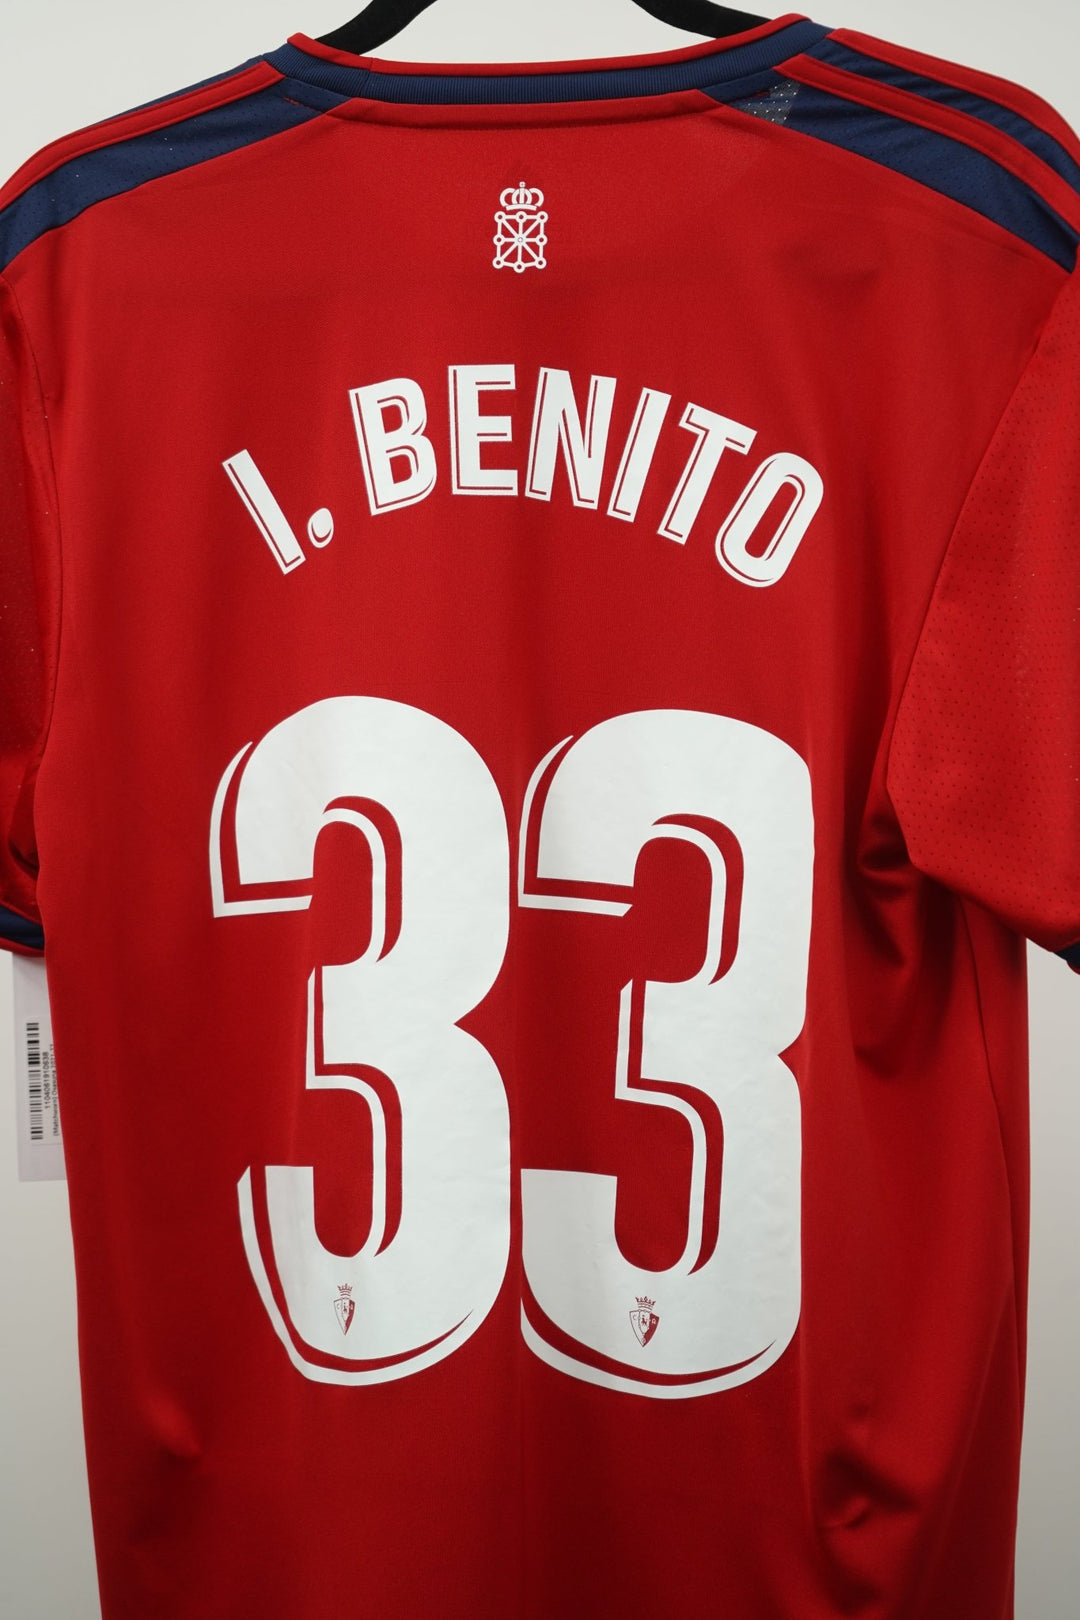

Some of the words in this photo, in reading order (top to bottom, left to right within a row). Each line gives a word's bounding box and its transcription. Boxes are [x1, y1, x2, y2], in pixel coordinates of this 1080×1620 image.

[222, 449, 334, 575] I.
[349, 364, 824, 588] BENITO
[43, 1051, 51, 1109] 1104061910638
[209, 695, 816, 1400] 33
